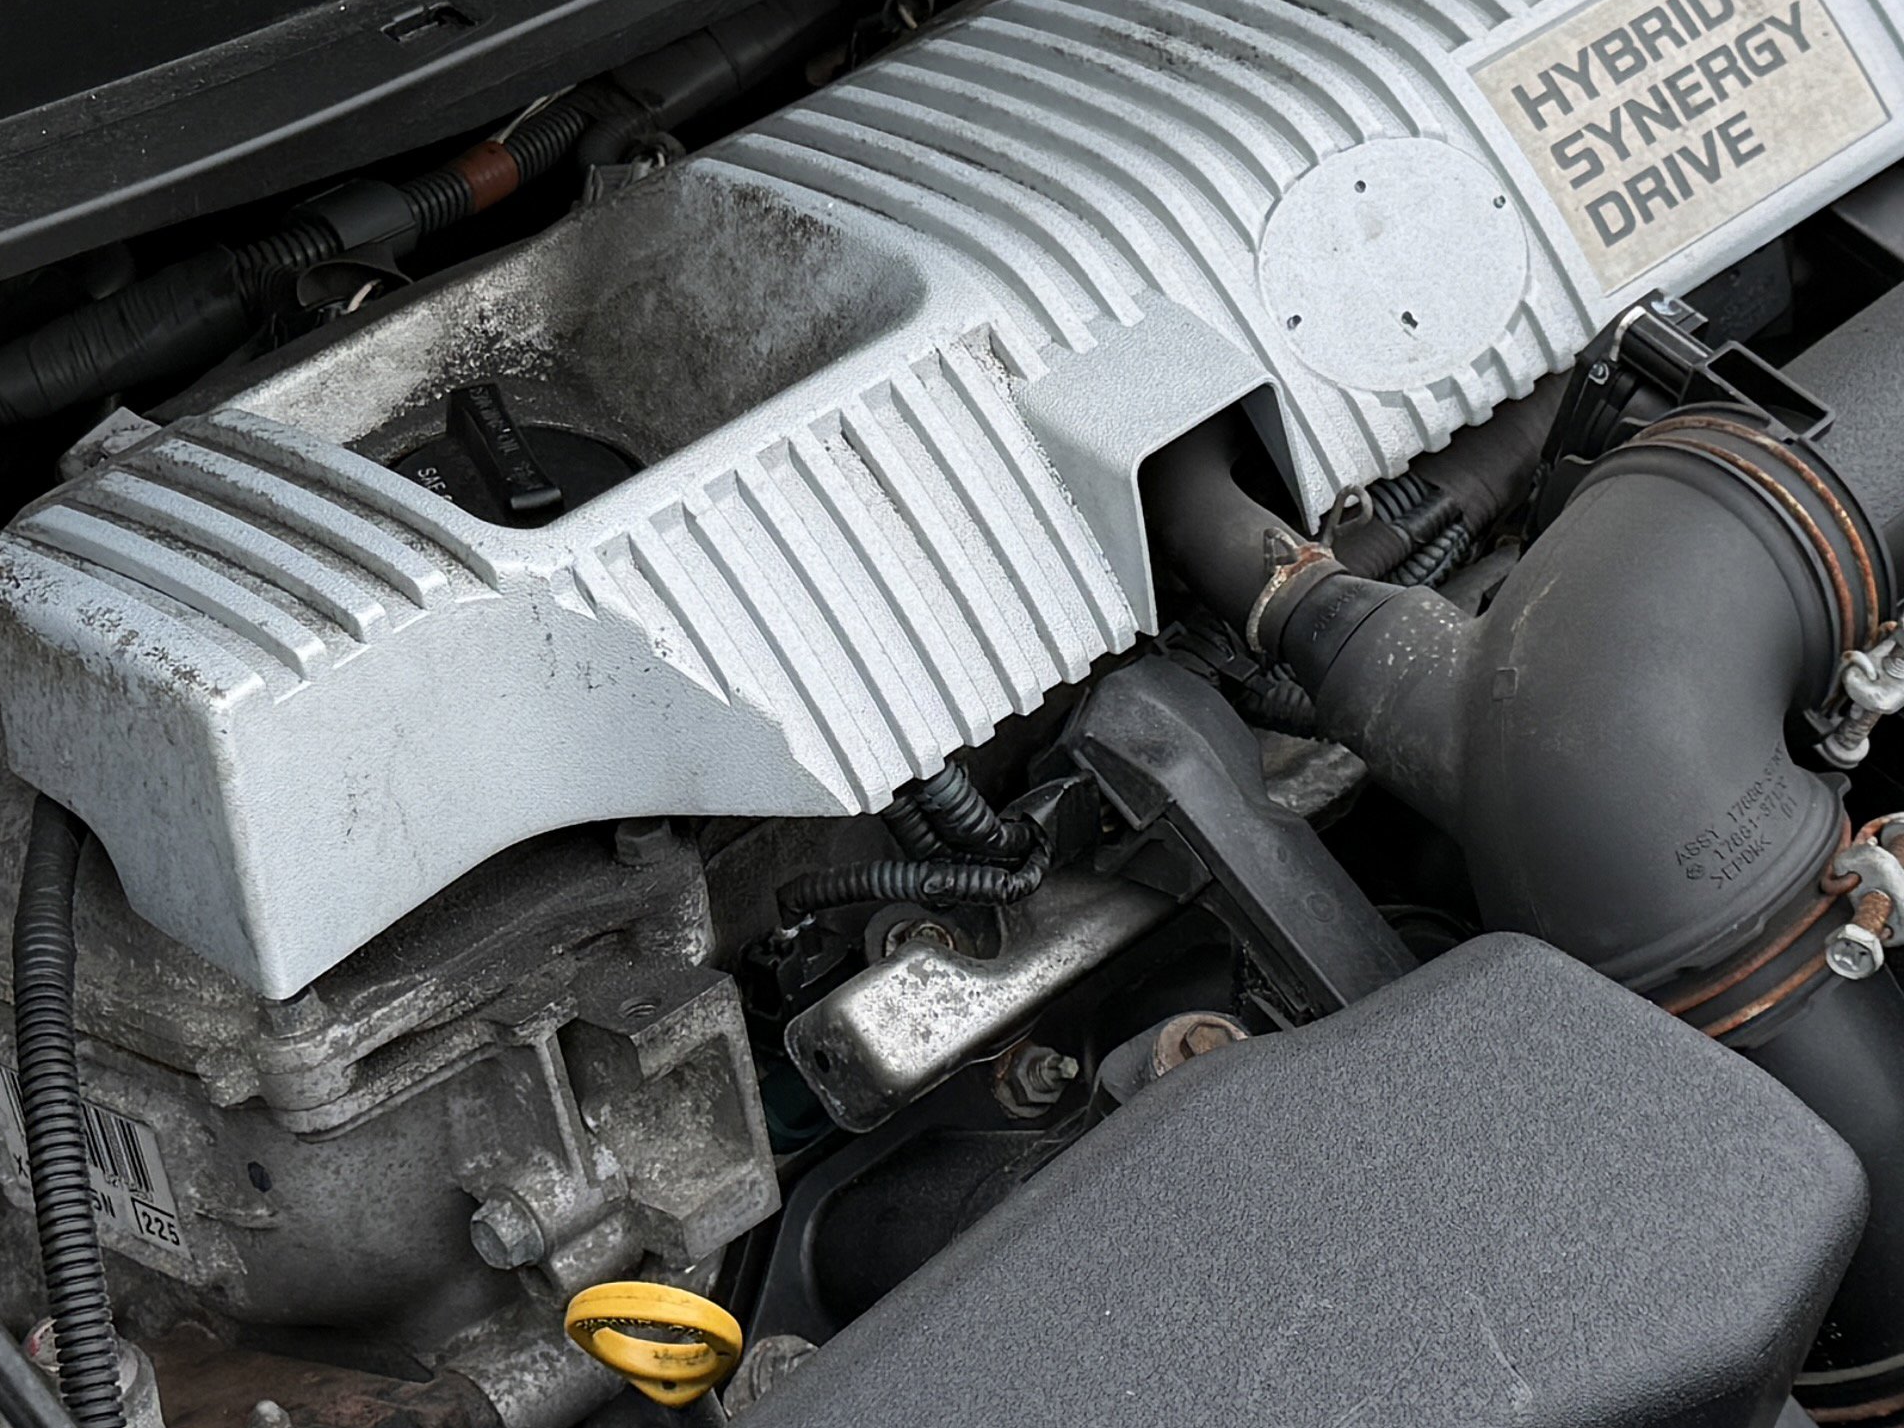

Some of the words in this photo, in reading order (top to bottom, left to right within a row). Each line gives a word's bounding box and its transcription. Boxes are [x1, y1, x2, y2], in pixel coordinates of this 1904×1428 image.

[1550, 0, 1812, 189] SYNERGY
[1583, 110, 1767, 248] DRIVE
[1675, 826, 1719, 866] ASSY
[142, 1211, 180, 1245] 225
